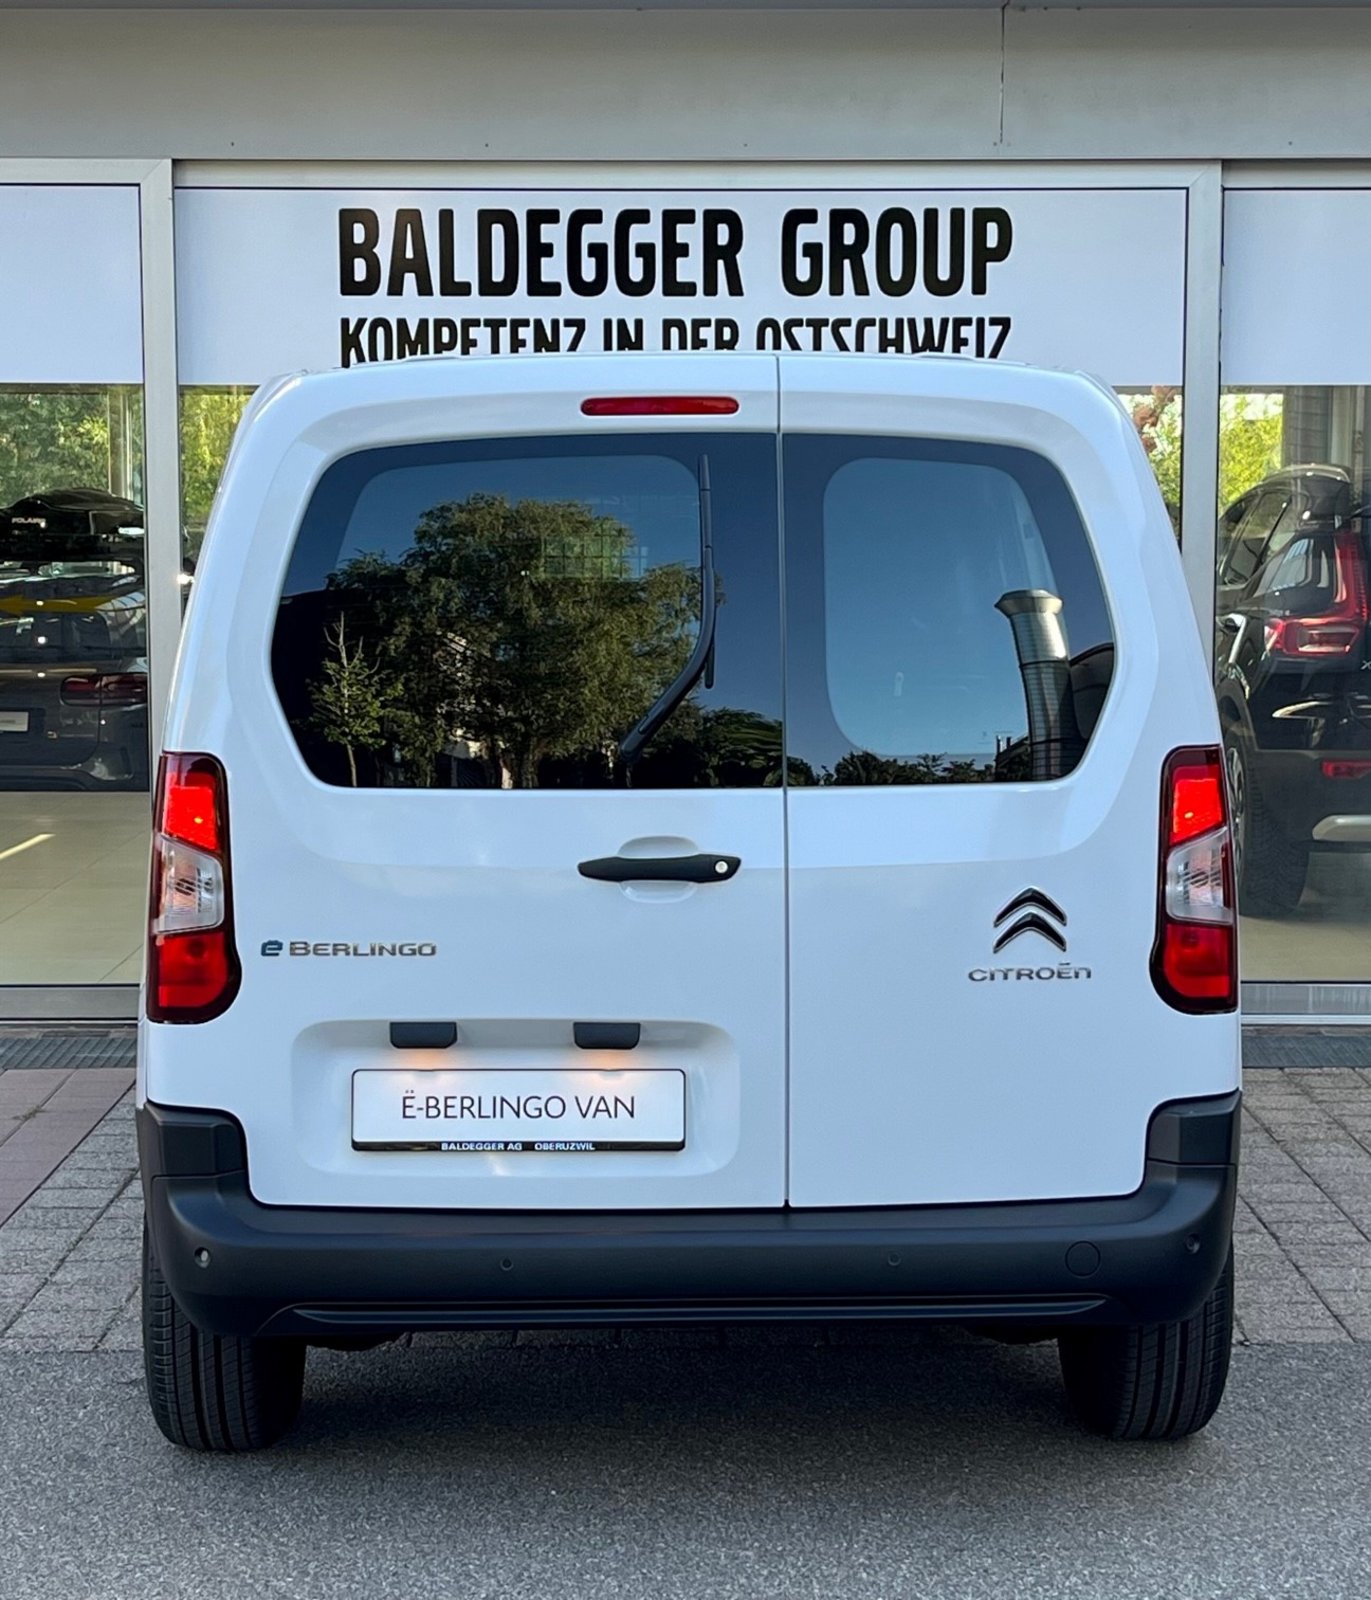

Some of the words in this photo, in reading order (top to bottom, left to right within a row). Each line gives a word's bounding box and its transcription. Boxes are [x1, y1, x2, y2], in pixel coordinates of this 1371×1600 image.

[338, 208, 744, 297] BALDEGGER
[781, 207, 1013, 297] GROUP
[340, 317, 586, 368] KOMPETENZ
[603, 318, 644, 352] IN
[662, 318, 740, 351] DER
[756, 316, 1011, 359] OSTSCHWEIZ
[289, 941, 437, 957] BERLINGO
[402, 1090, 566, 1119] Ë-BERLINGO
[574, 1096, 635, 1119] VAN
[441, 1142, 505, 1151] BALDEGGER
[507, 1142, 523, 1151] AG
[534, 1142, 596, 1151] OBERUZWIL
